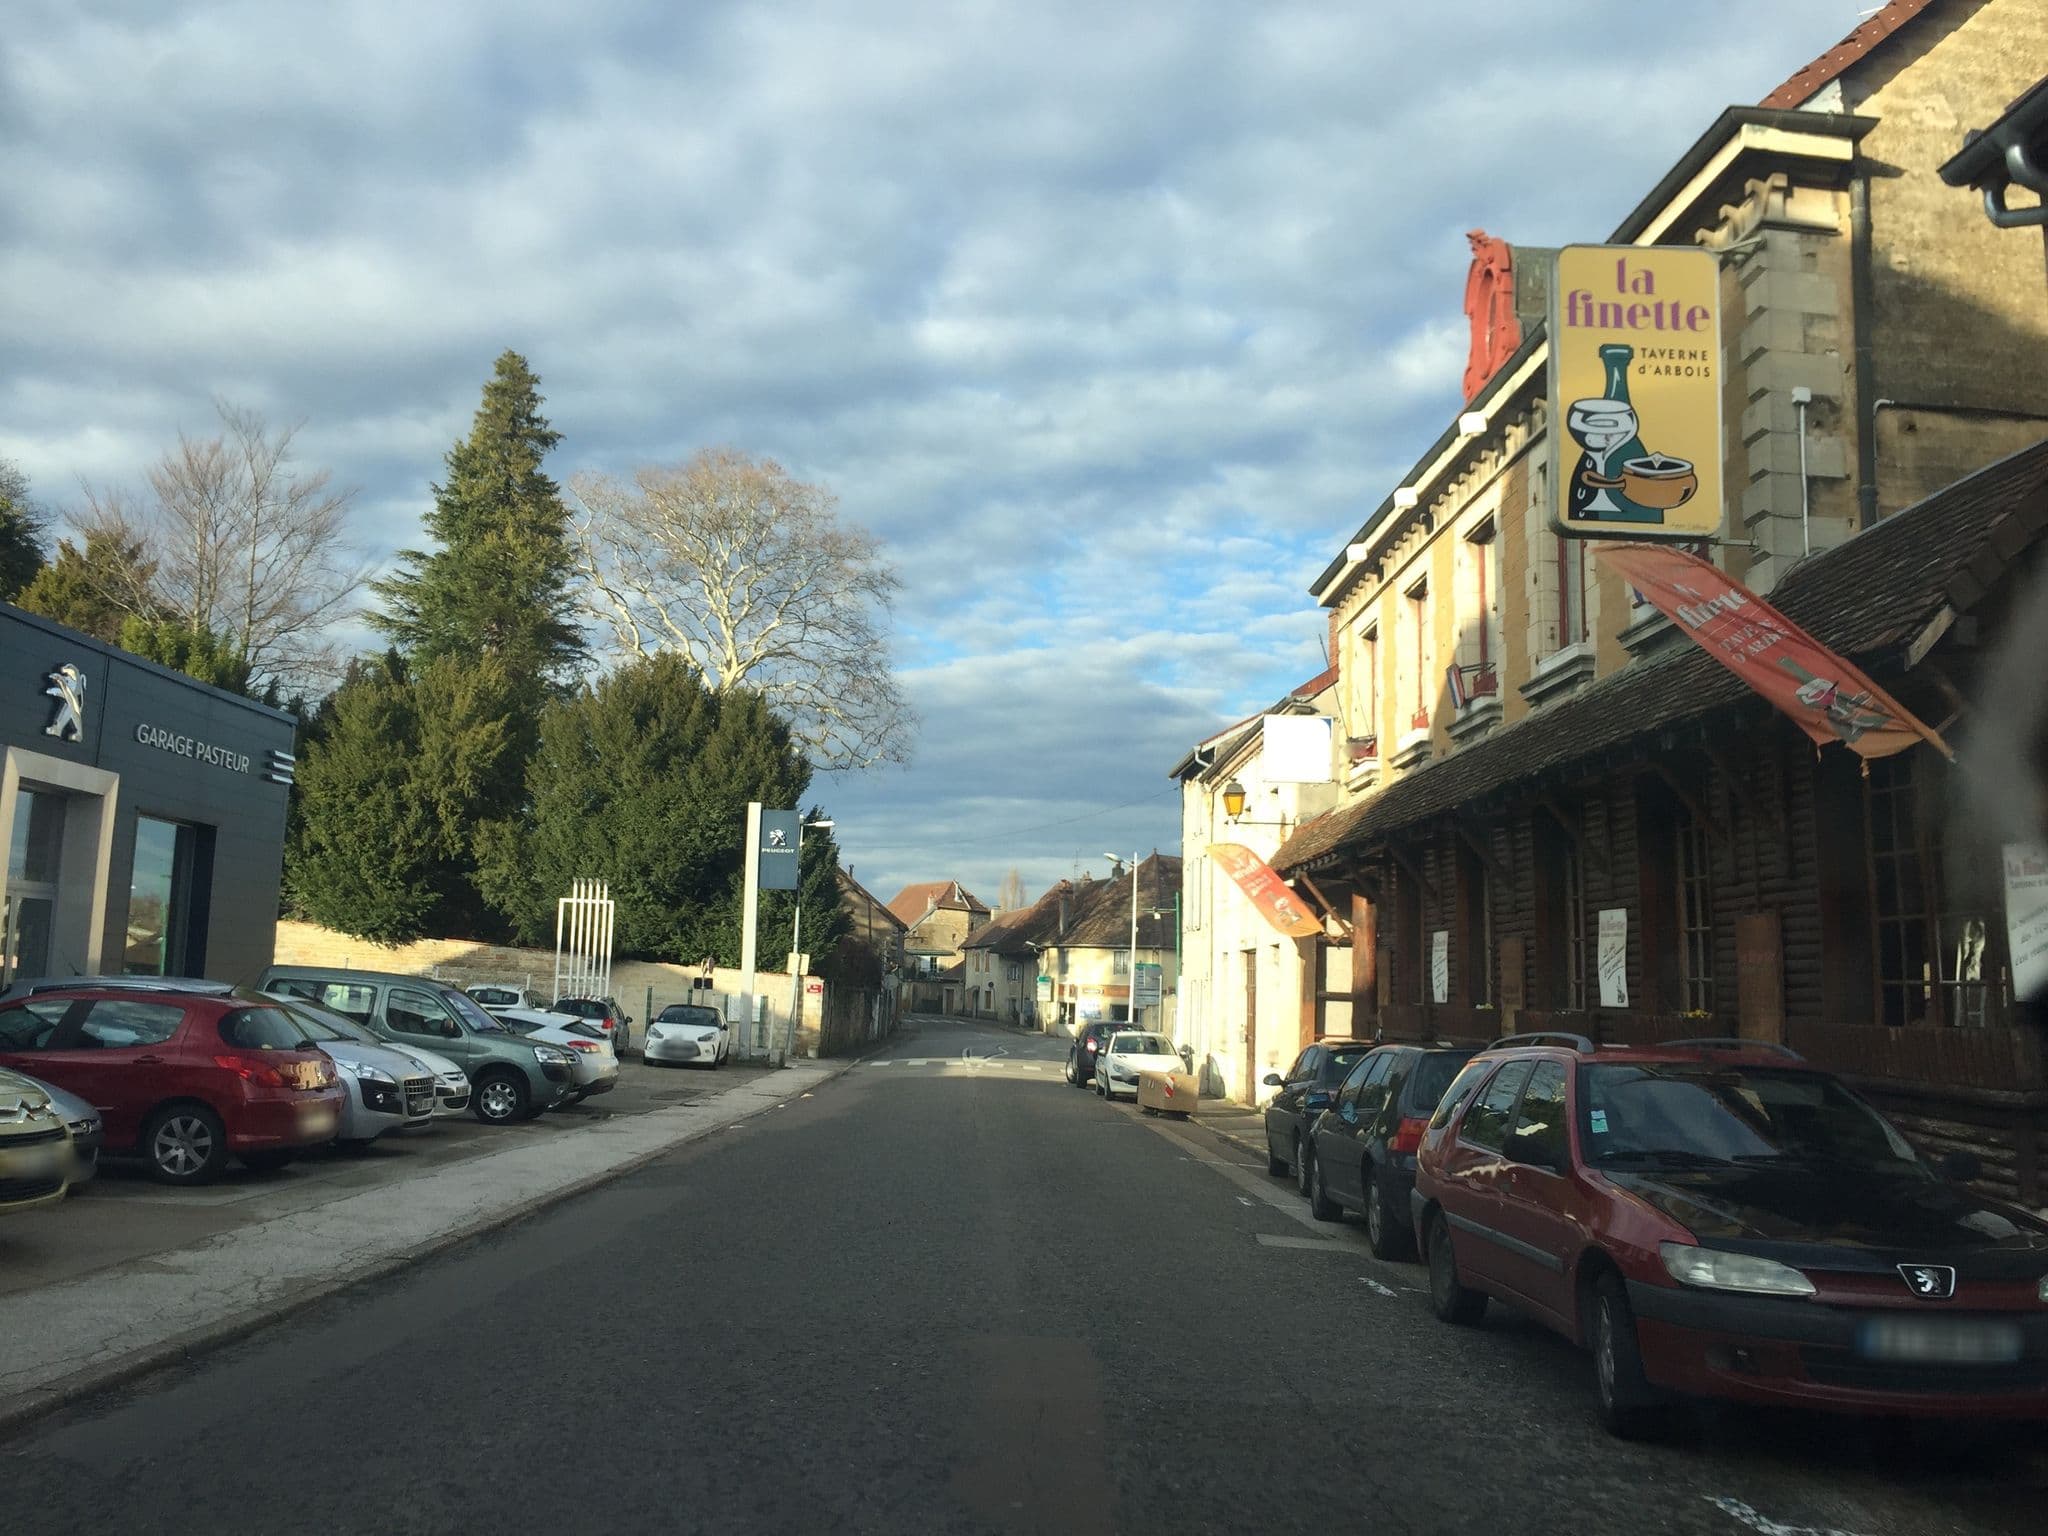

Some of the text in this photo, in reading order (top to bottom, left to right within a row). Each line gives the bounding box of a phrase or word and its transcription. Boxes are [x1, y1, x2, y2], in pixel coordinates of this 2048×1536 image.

[1616, 256, 1656, 295] la
[1566, 289, 1711, 332] finette
[1638, 364, 1711, 378] d'ARBOIS
[1640, 347, 1709, 361] TAVERNE
[137, 723, 250, 774] GARAGE PASTEUR
